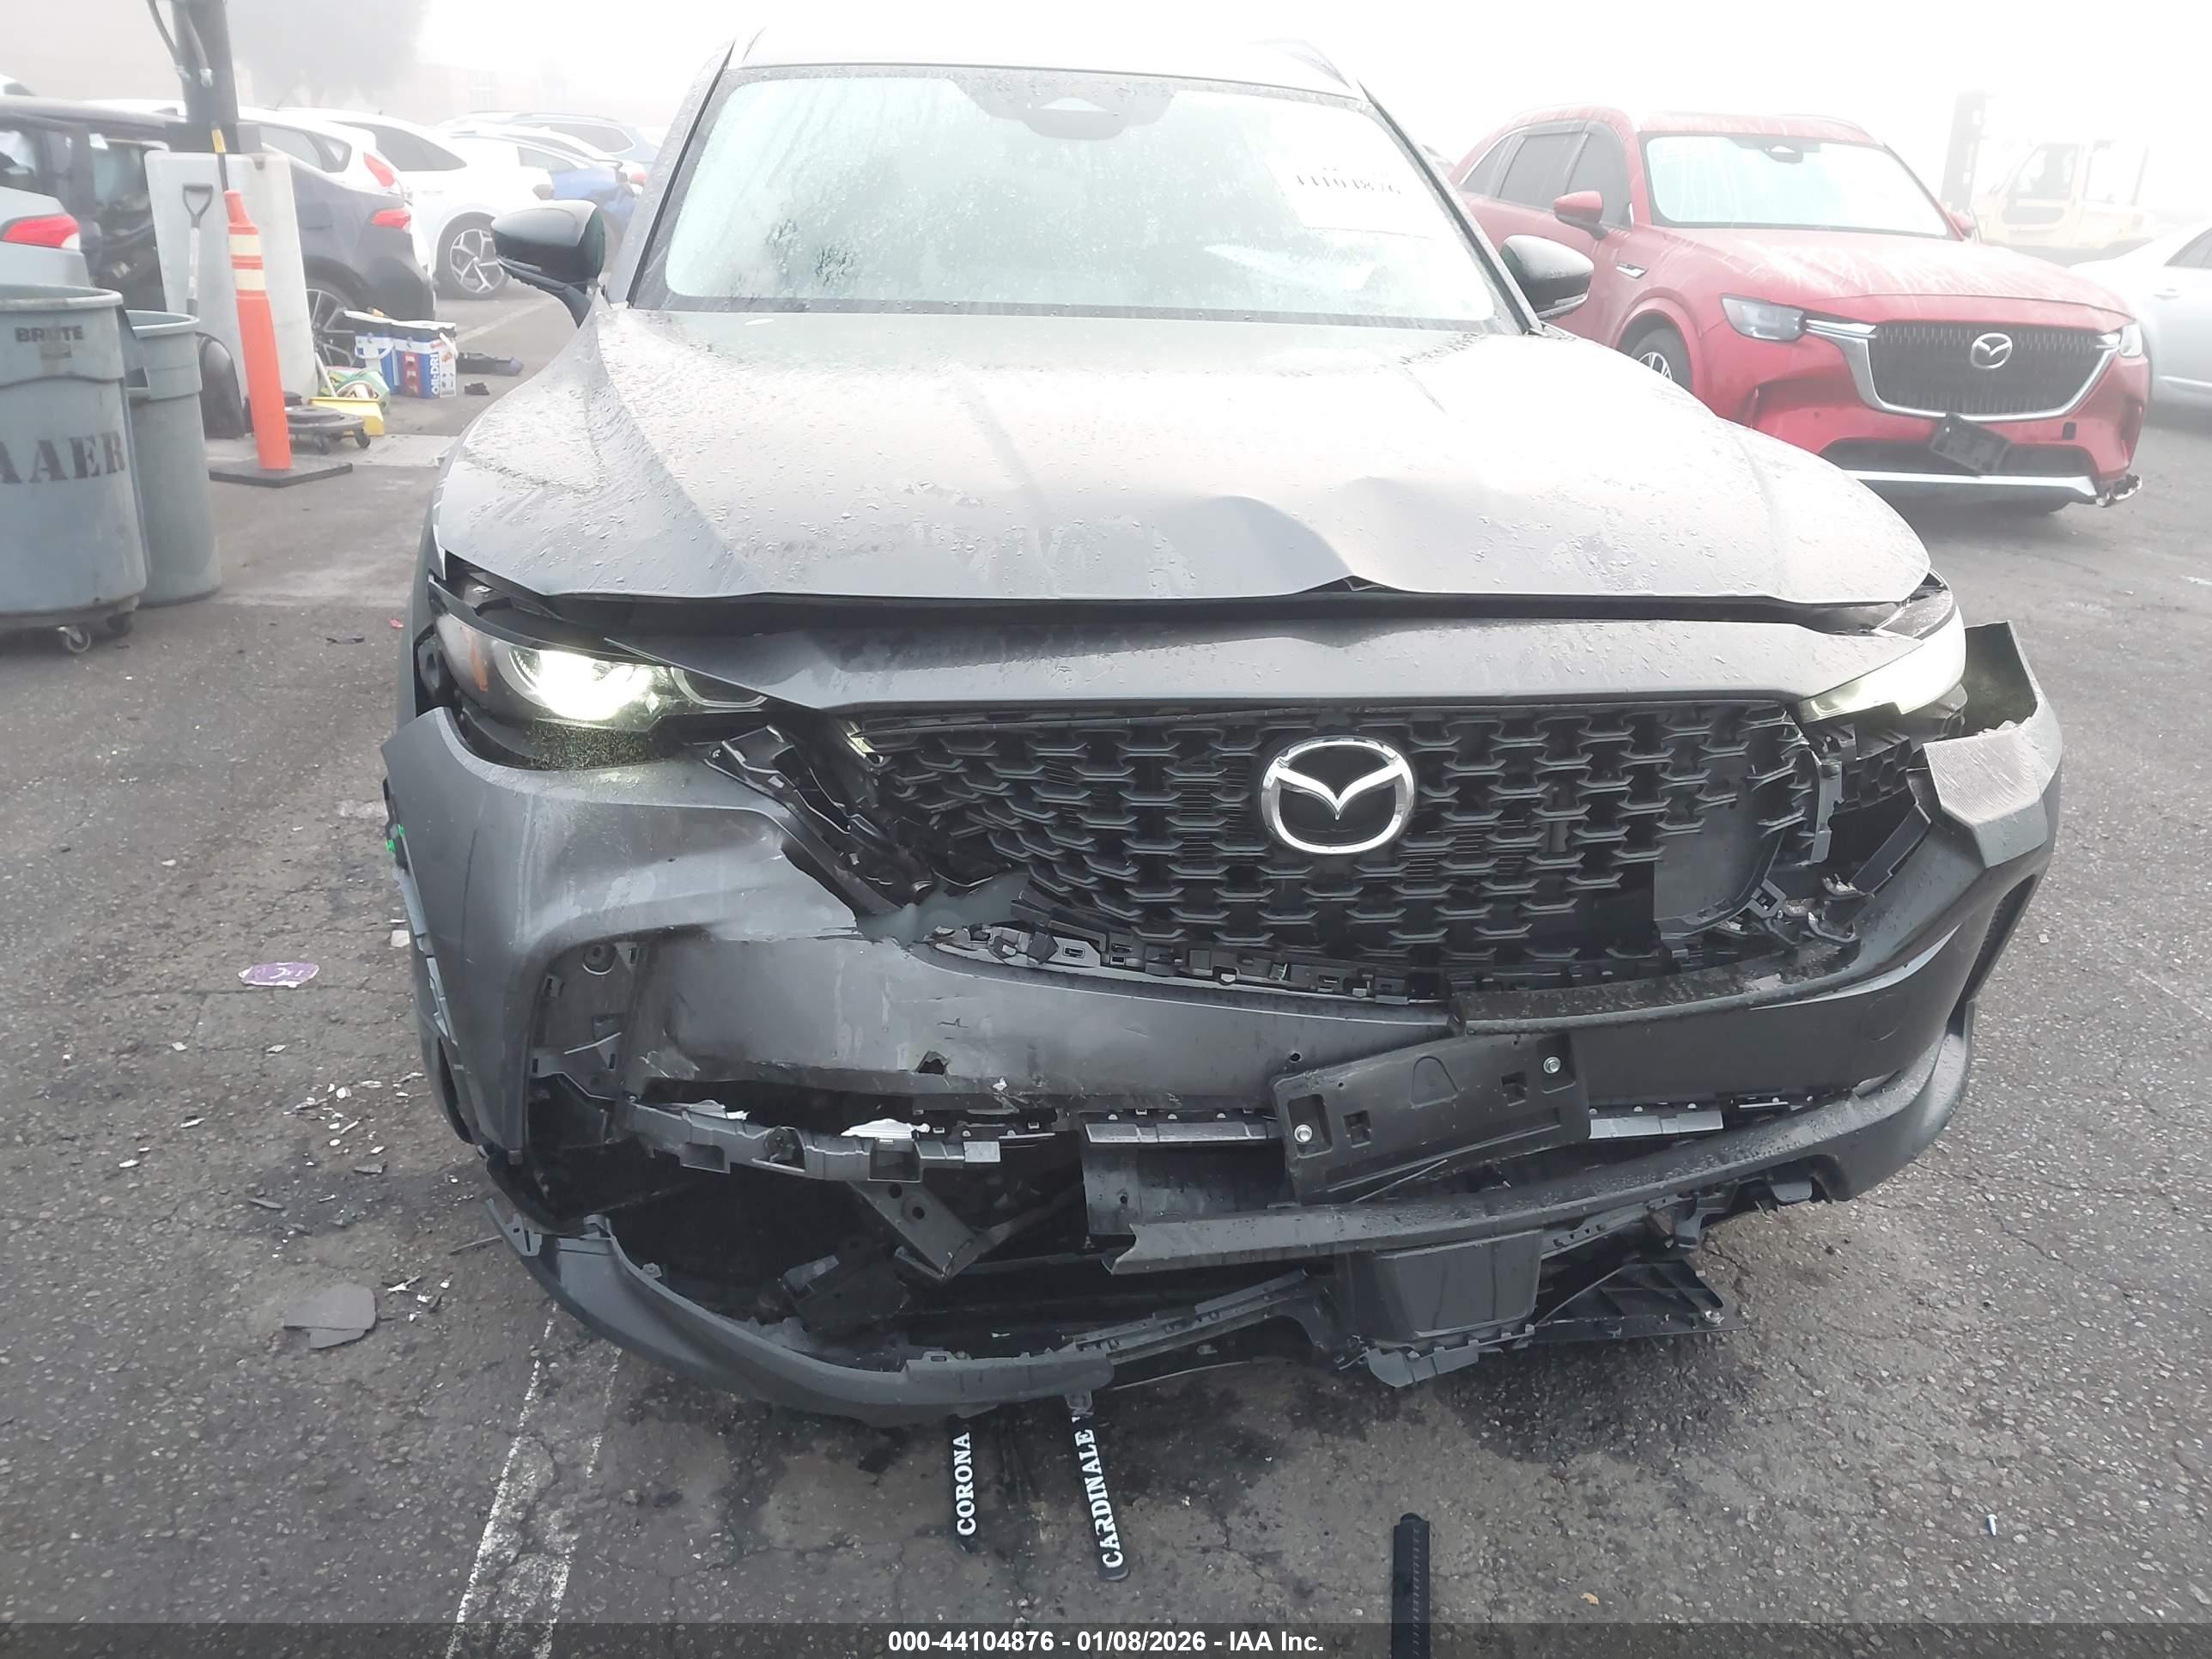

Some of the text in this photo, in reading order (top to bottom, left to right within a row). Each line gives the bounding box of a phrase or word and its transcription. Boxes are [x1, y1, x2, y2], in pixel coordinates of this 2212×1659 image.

[15, 325, 83, 343] BRUTE
[429, 352, 439, 394] OIL-DRI
[952, 1431, 976, 1535] CORONA
[1074, 1428, 1124, 1568] CARDINALE
